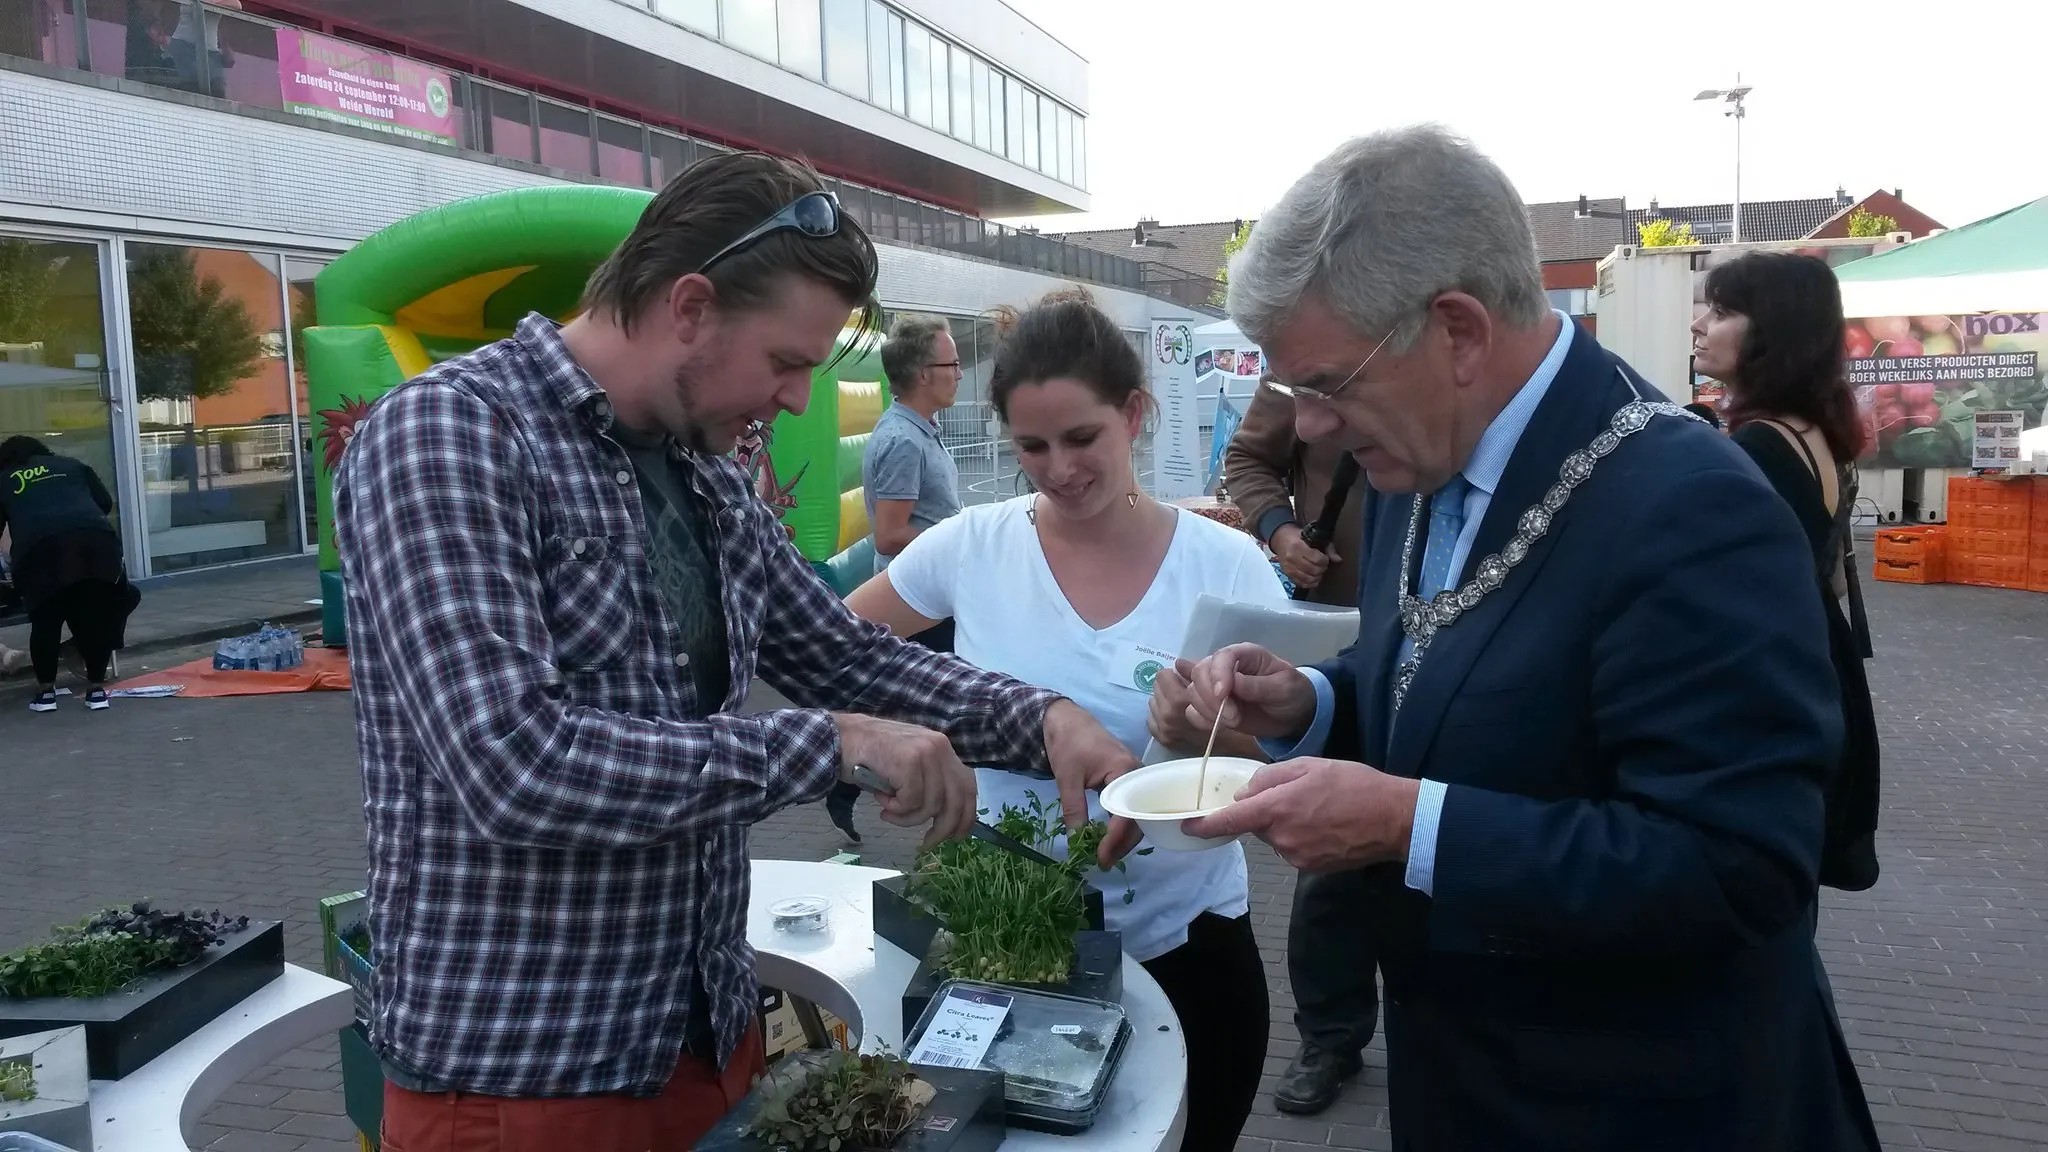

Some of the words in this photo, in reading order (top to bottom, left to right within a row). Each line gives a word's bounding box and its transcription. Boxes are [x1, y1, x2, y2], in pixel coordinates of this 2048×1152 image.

[294, 71, 333, 92] Zaterdag
[333, 81, 344, 94] 24
[344, 85, 386, 104] september
[388, 94, 426, 113] 12:00-17:00
[294, 106, 316, 117] Gratis
[338, 96, 363, 113] Weide
[363, 102, 394, 120] Wereld
[1965, 313, 2040, 337] box
[1855, 359, 1876, 371] BOX
[1878, 358, 1898, 370] VOL
[1900, 357, 1932, 369] VERSE
[1934, 355, 1998, 367] PRODUCTEN
[1999, 353, 2035, 365] DIRECT
[1850, 371, 1876, 383] BOER
[1878, 370, 1933, 381] WEKELIJKS
[1936, 369, 1958, 380] AAN
[1960, 367, 1985, 379] HUIS
[1987, 366, 2035, 378] BEZORGD
[10, 465, 49, 494] Jou
[946, 1008, 965, 1017] Citra
